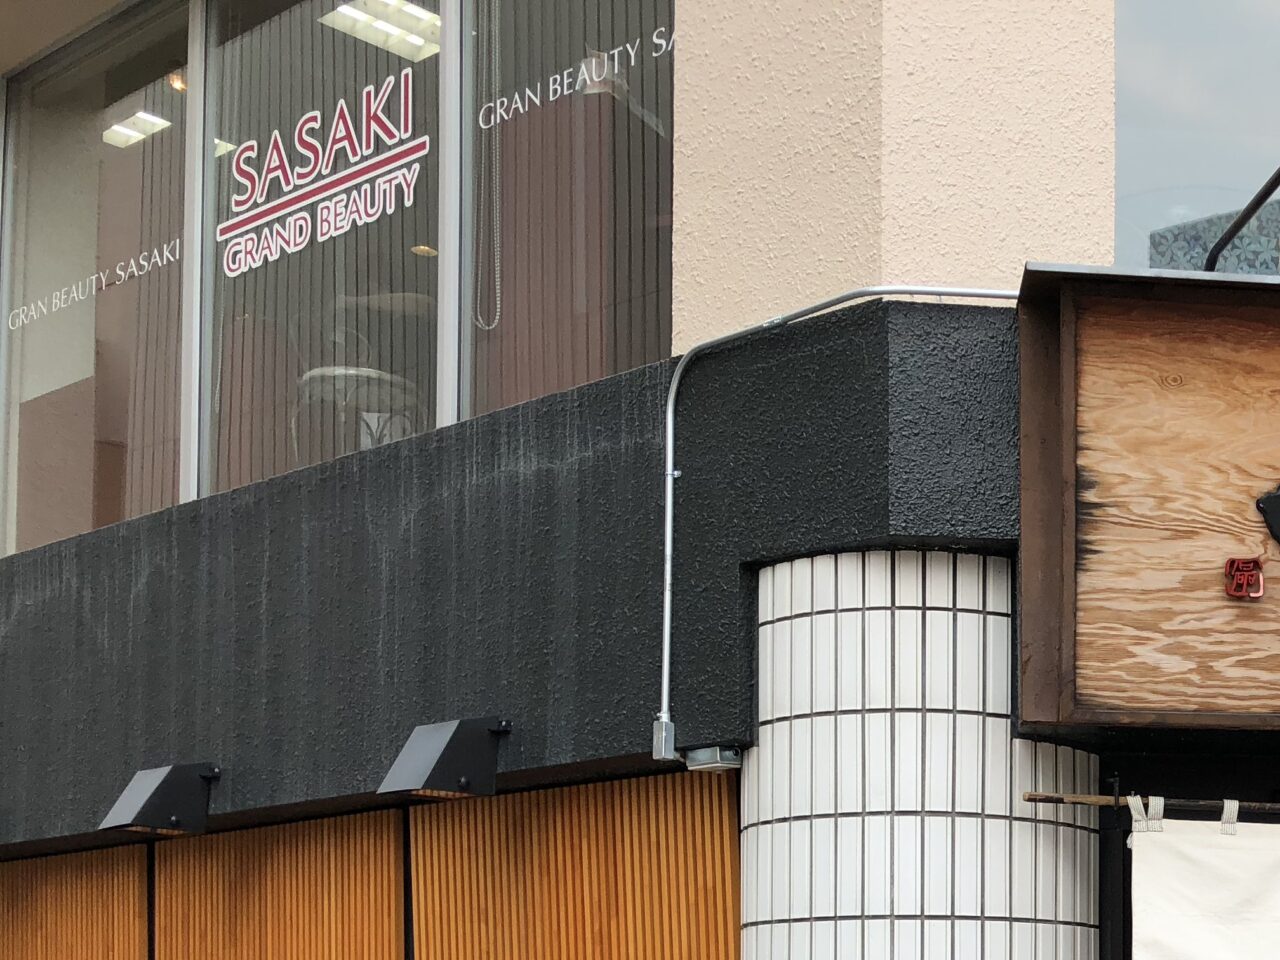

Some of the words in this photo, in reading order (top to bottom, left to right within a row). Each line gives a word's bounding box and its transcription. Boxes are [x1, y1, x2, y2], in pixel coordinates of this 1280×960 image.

[479, 82, 541, 129] GRAN
[549, 38, 640, 101] BEAUTY
[652, 26, 675, 57] S
[232, 67, 413, 212] SASAKI
[224, 212, 312, 278] GRAND
[317, 163, 420, 242] BEAUTY
[8, 296, 48, 330] GRAN
[52, 269, 109, 312] BEAUTY
[115, 238, 180, 285] SASAKI
